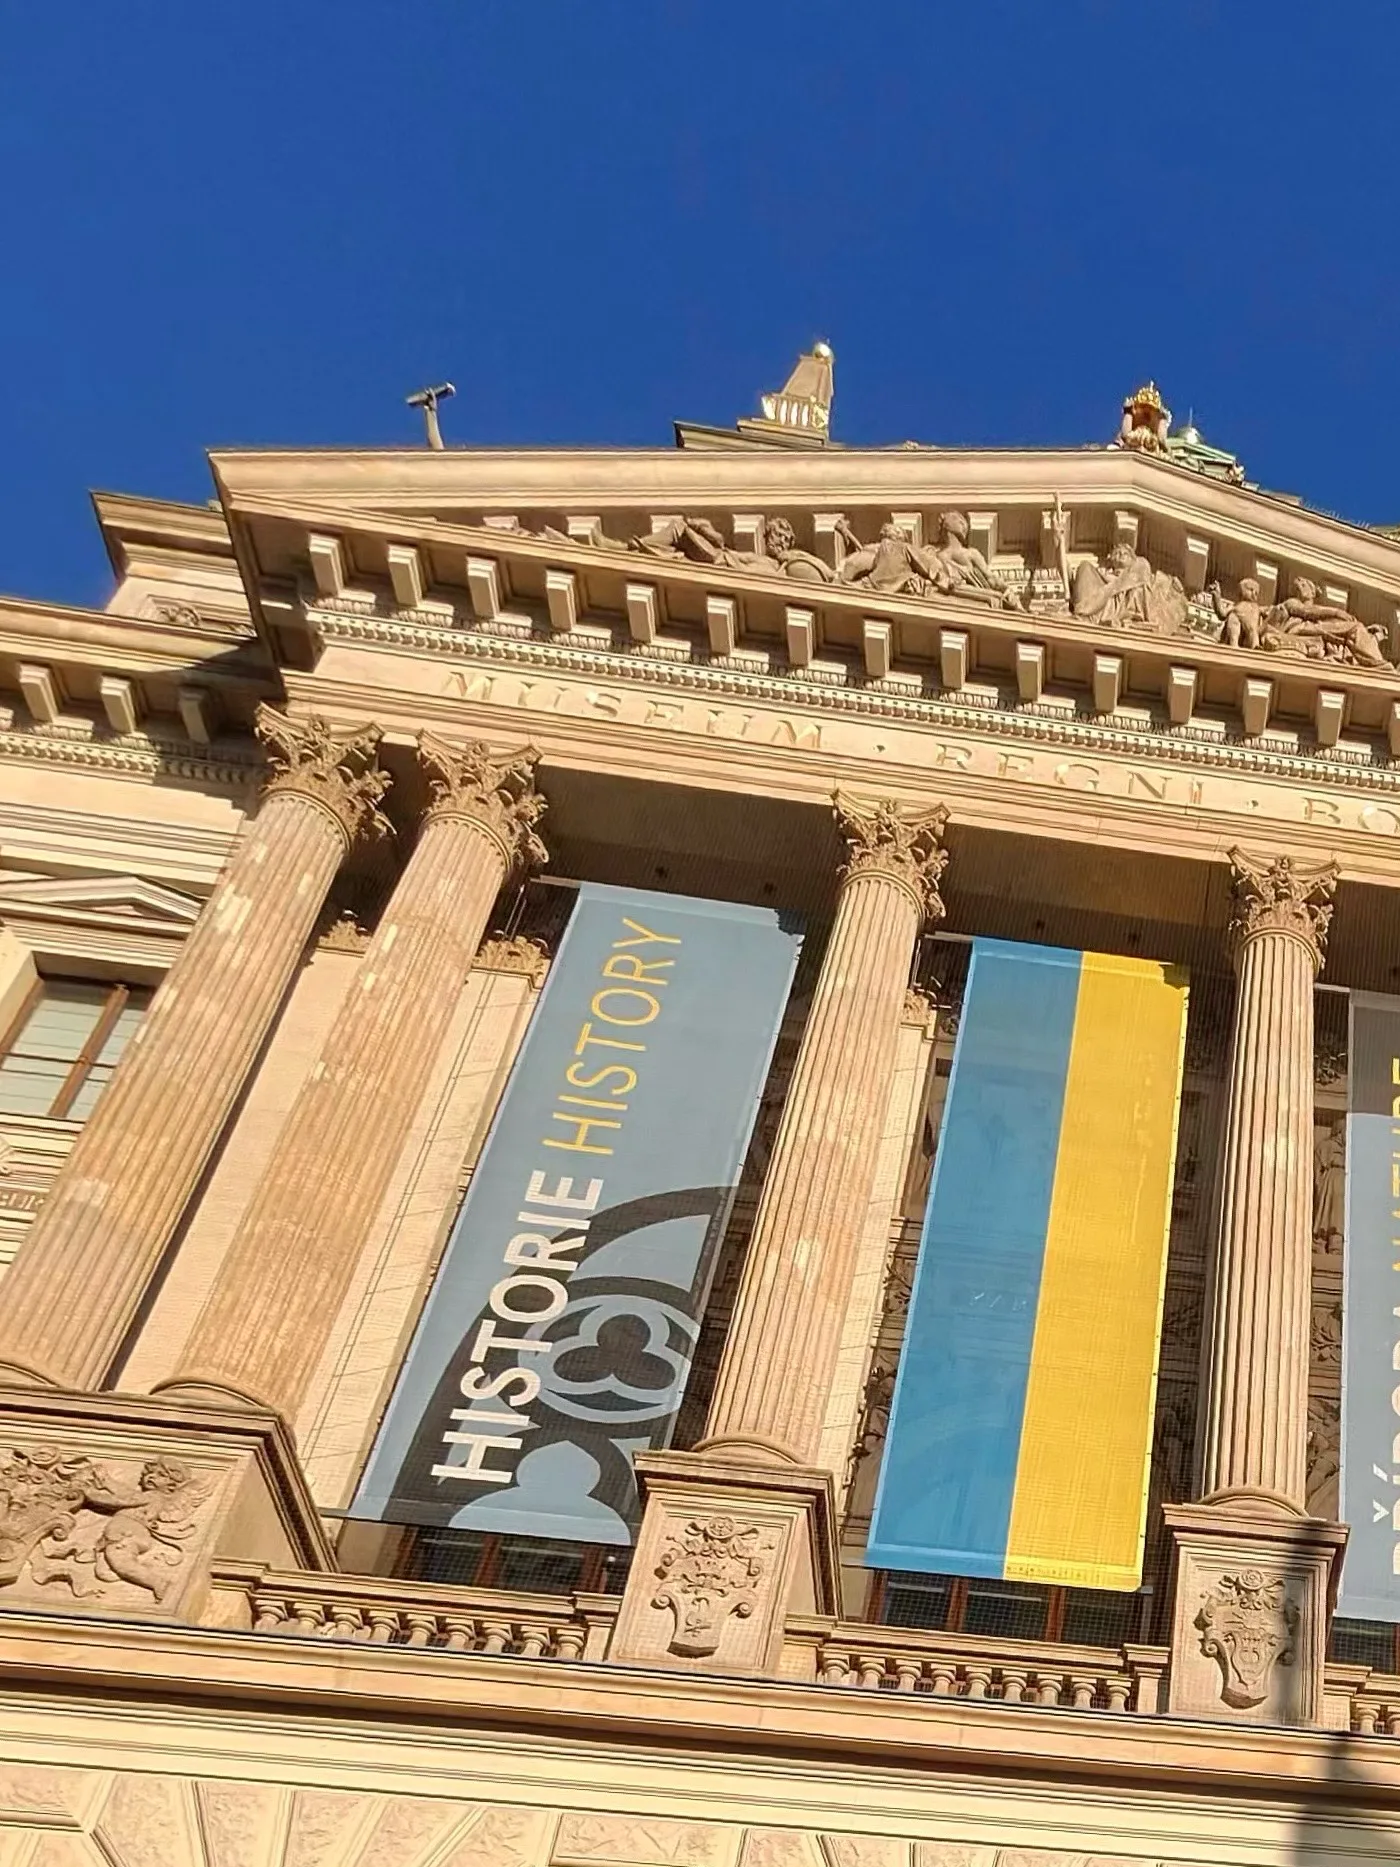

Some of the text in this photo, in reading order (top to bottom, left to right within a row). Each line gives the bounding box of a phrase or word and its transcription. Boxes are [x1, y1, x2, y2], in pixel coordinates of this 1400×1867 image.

[441, 671, 822, 749] MUSEUM
[935, 743, 1203, 804] REGNI
[431, 917, 682, 1484] HISTORIE HISTORY
